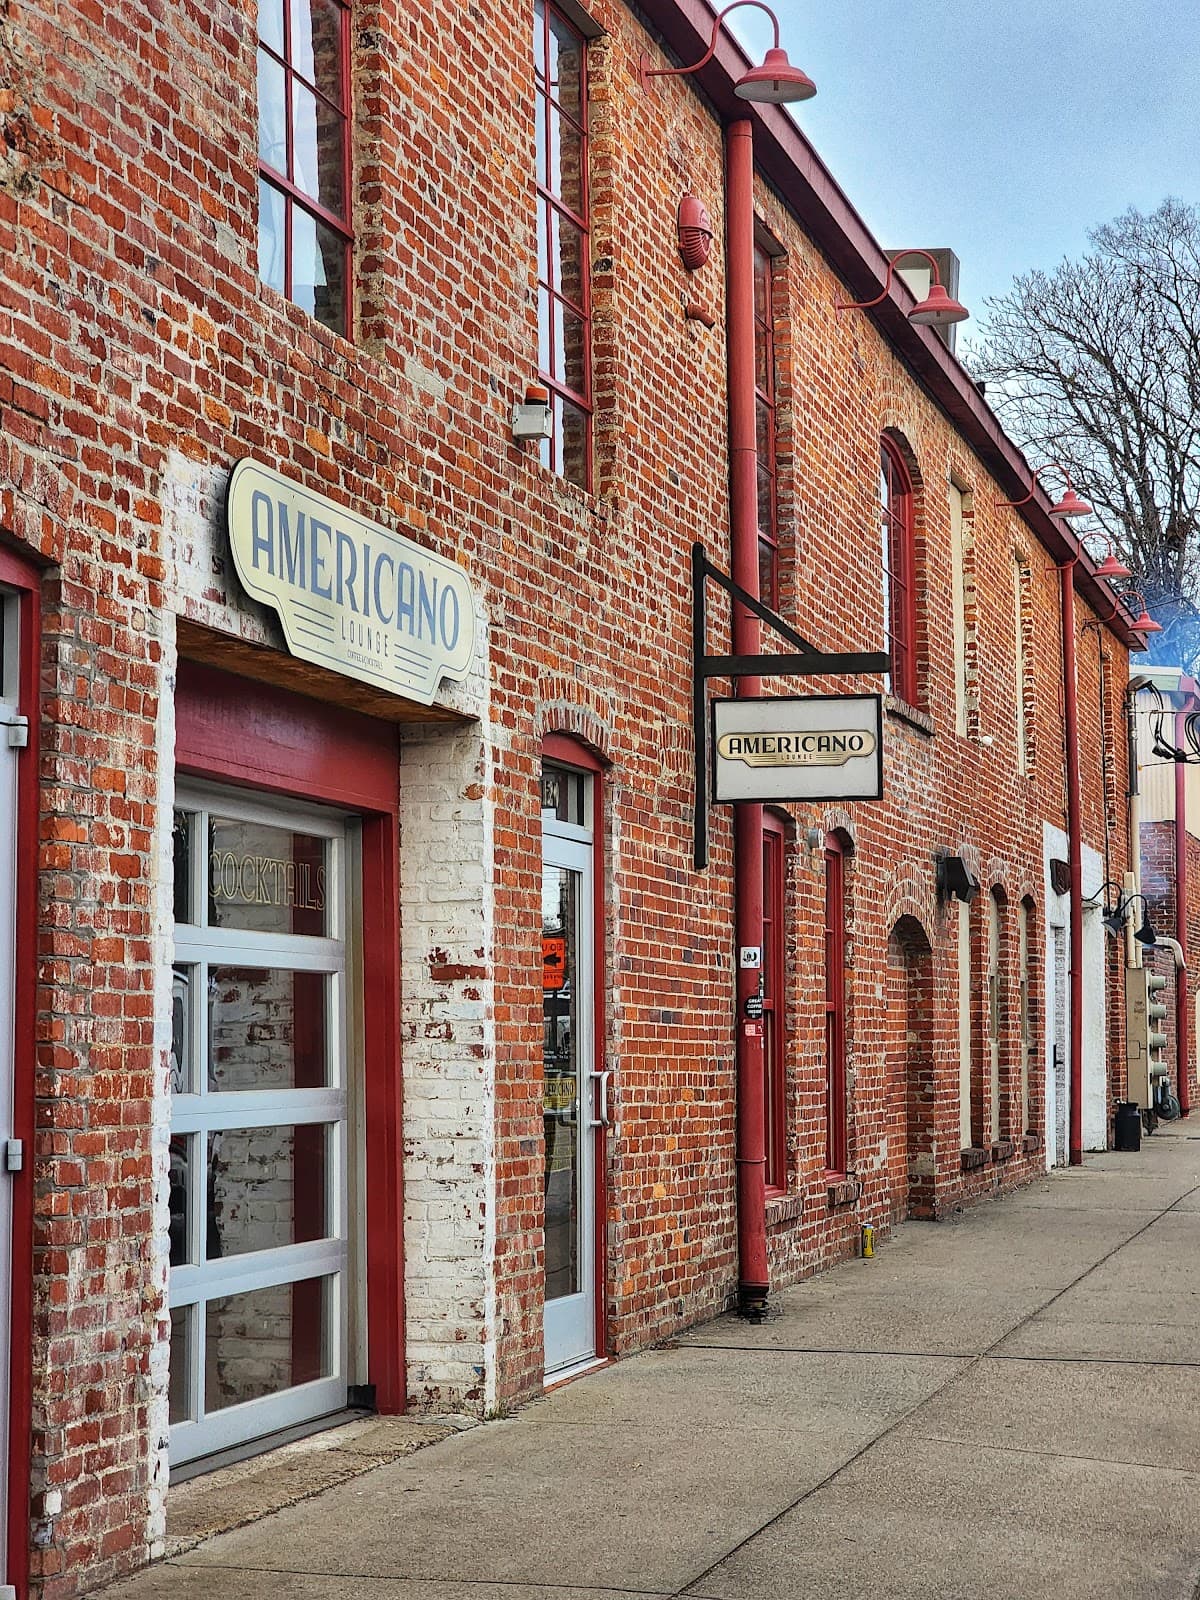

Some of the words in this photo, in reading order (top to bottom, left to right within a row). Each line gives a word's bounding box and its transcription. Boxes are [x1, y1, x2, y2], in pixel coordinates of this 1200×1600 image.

[251, 489, 460, 651] AMERICANO
[341, 616, 389, 658] LOUNGE
[729, 735, 864, 754] AMERICANO
